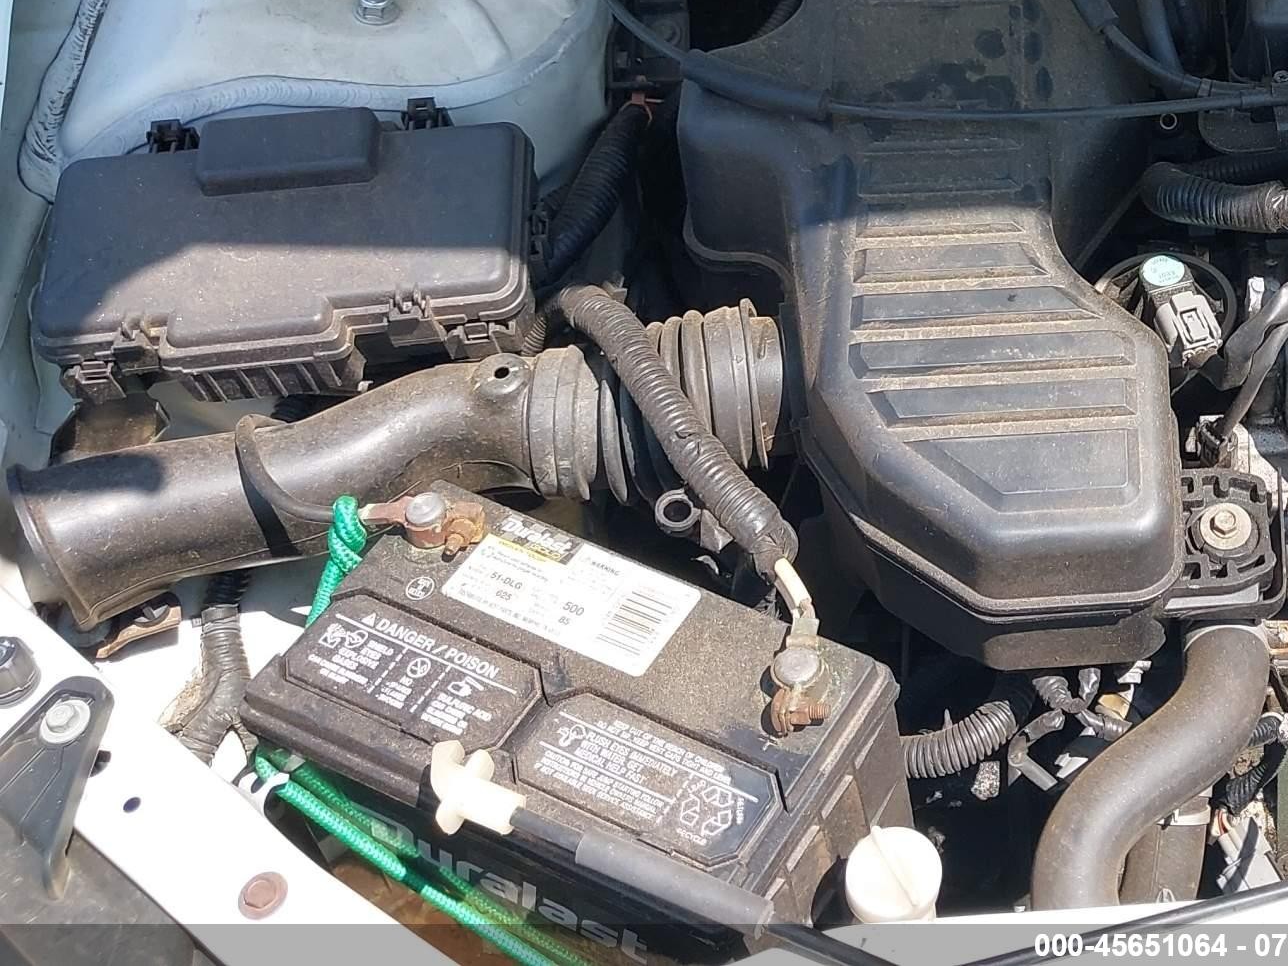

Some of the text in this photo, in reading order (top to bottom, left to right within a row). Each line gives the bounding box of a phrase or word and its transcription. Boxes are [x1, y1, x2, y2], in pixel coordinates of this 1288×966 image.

[501, 516, 573, 552] Duralast
[562, 601, 585, 617] 500
[375, 616, 435, 651] DANGER
[443, 646, 499, 679] POISON
[585, 731, 612, 747] FLUSH
